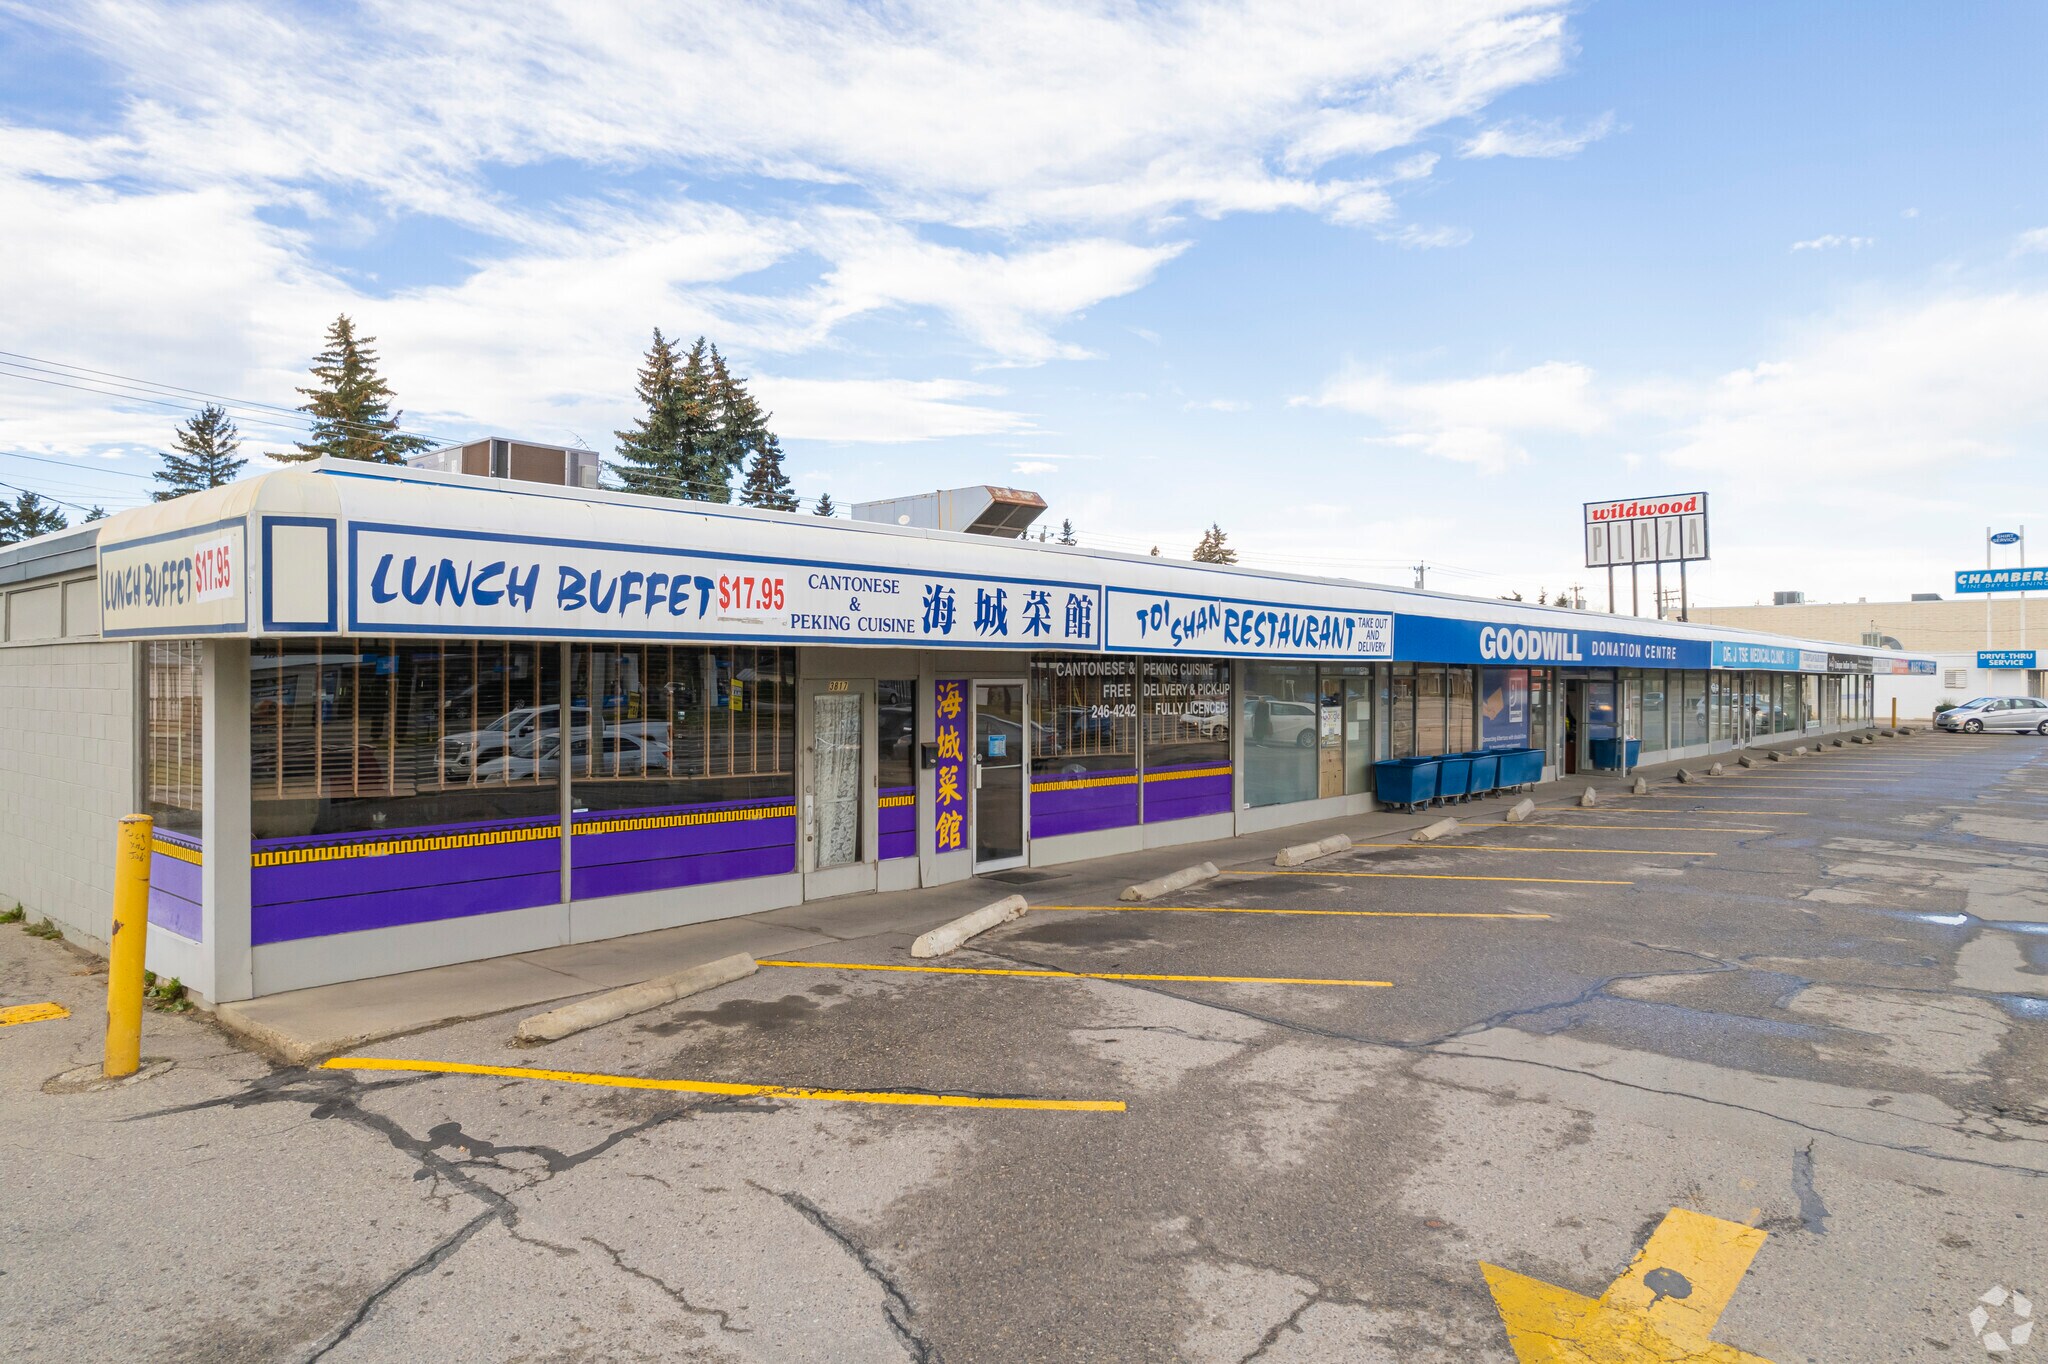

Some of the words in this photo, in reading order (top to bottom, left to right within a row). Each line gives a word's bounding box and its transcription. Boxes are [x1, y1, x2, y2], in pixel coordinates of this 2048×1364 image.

[1592, 496, 1697, 521] wildwood
[1592, 518, 1699, 562] PLAZA
[195, 545, 231, 594] $17.95
[105, 564, 142, 610] LUNCH
[144, 557, 192, 607] BUFFET
[371, 554, 540, 613] LUNCH
[557, 565, 715, 620] BUFFET
[718, 574, 784, 612] $17.95
[808, 574, 900, 594] CANTONESE
[849, 596, 862, 612] &
[922, 584, 1093, 638] 海城菜館
[790, 614, 850, 630] PEKING
[857, 617, 915, 633] CUISINE
[1171, 598, 1221, 647] SHAN
[1224, 608, 1355, 651] RESTAURANT
[1358, 617, 1374, 628] TAKE
[1375, 618, 1388, 629] OUT
[1366, 629, 1380, 641] AND
[1479, 626, 1582, 661] GOODWILL
[1592, 641, 1641, 658] DONATION
[1645, 645, 1677, 660] CENTRE
[1357, 641, 1386, 653] DELIVERY
[1750, 648, 1770, 663] MEDICAL
[1771, 649, 1784, 664] CLINIC
[1056, 662, 1125, 676] CANTONESE
[1128, 663, 1136, 675] &
[1144, 663, 1178, 676] PEKING
[1180, 663, 1214, 676] CUISINE
[829, 681, 848, 692] 3817
[1103, 683, 1131, 698] FREE
[1144, 683, 1187, 696] DELIVERY
[1189, 684, 1196, 695] &
[1198, 683, 1230, 695] PICK-UP
[1091, 704, 1136, 718] 246-4242
[1155, 702, 1184, 715] FULLY
[1185, 701, 1226, 714] LICENCED
[936, 682, 963, 848] 海城菜館
